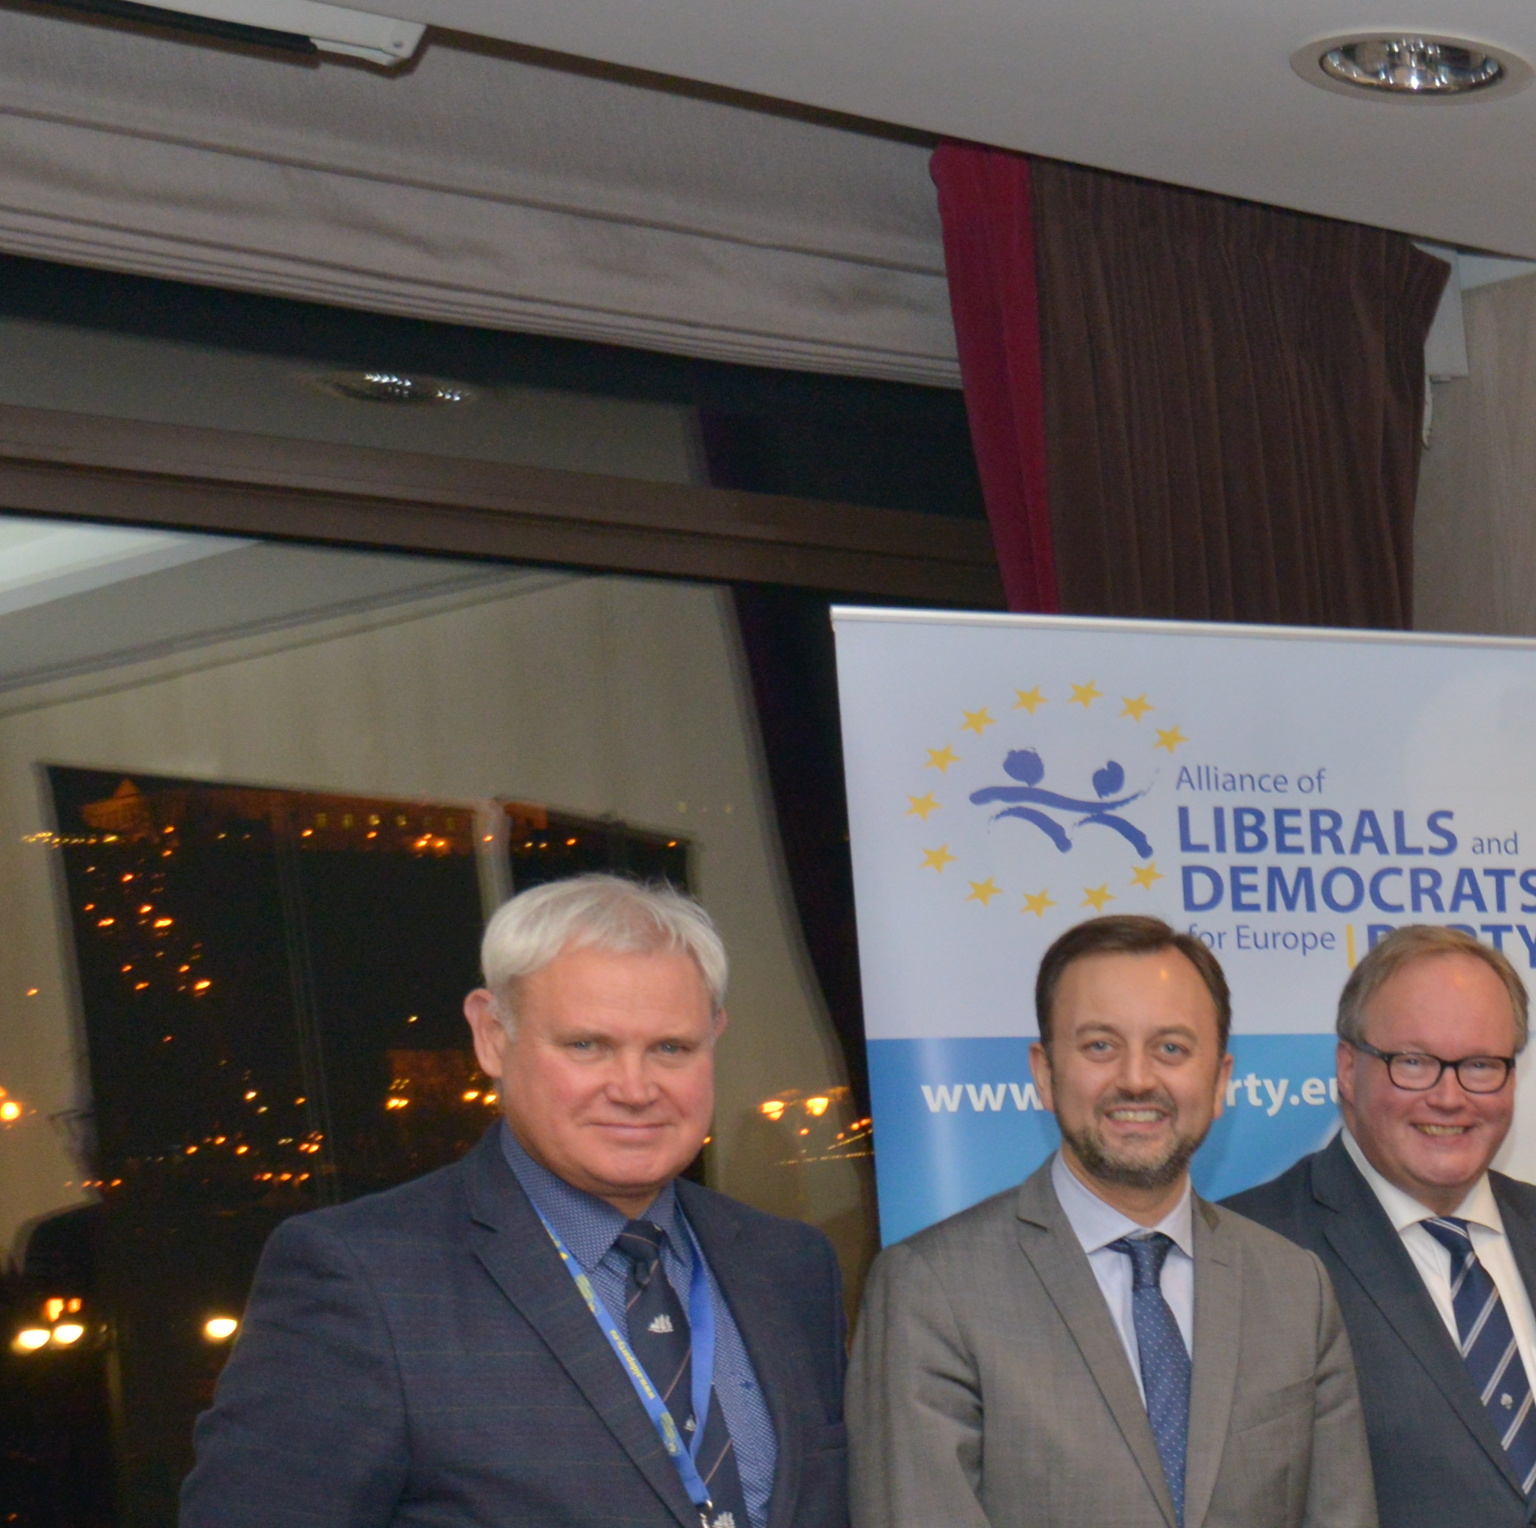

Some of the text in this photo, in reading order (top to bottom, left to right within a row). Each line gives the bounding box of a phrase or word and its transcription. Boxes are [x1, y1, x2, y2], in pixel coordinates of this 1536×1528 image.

[1175, 766, 1327, 793] Alliance of
[1178, 806, 1519, 855] LIBERALS and
[1188, 924, 1227, 950] for
[1236, 925, 1336, 956] Europe
